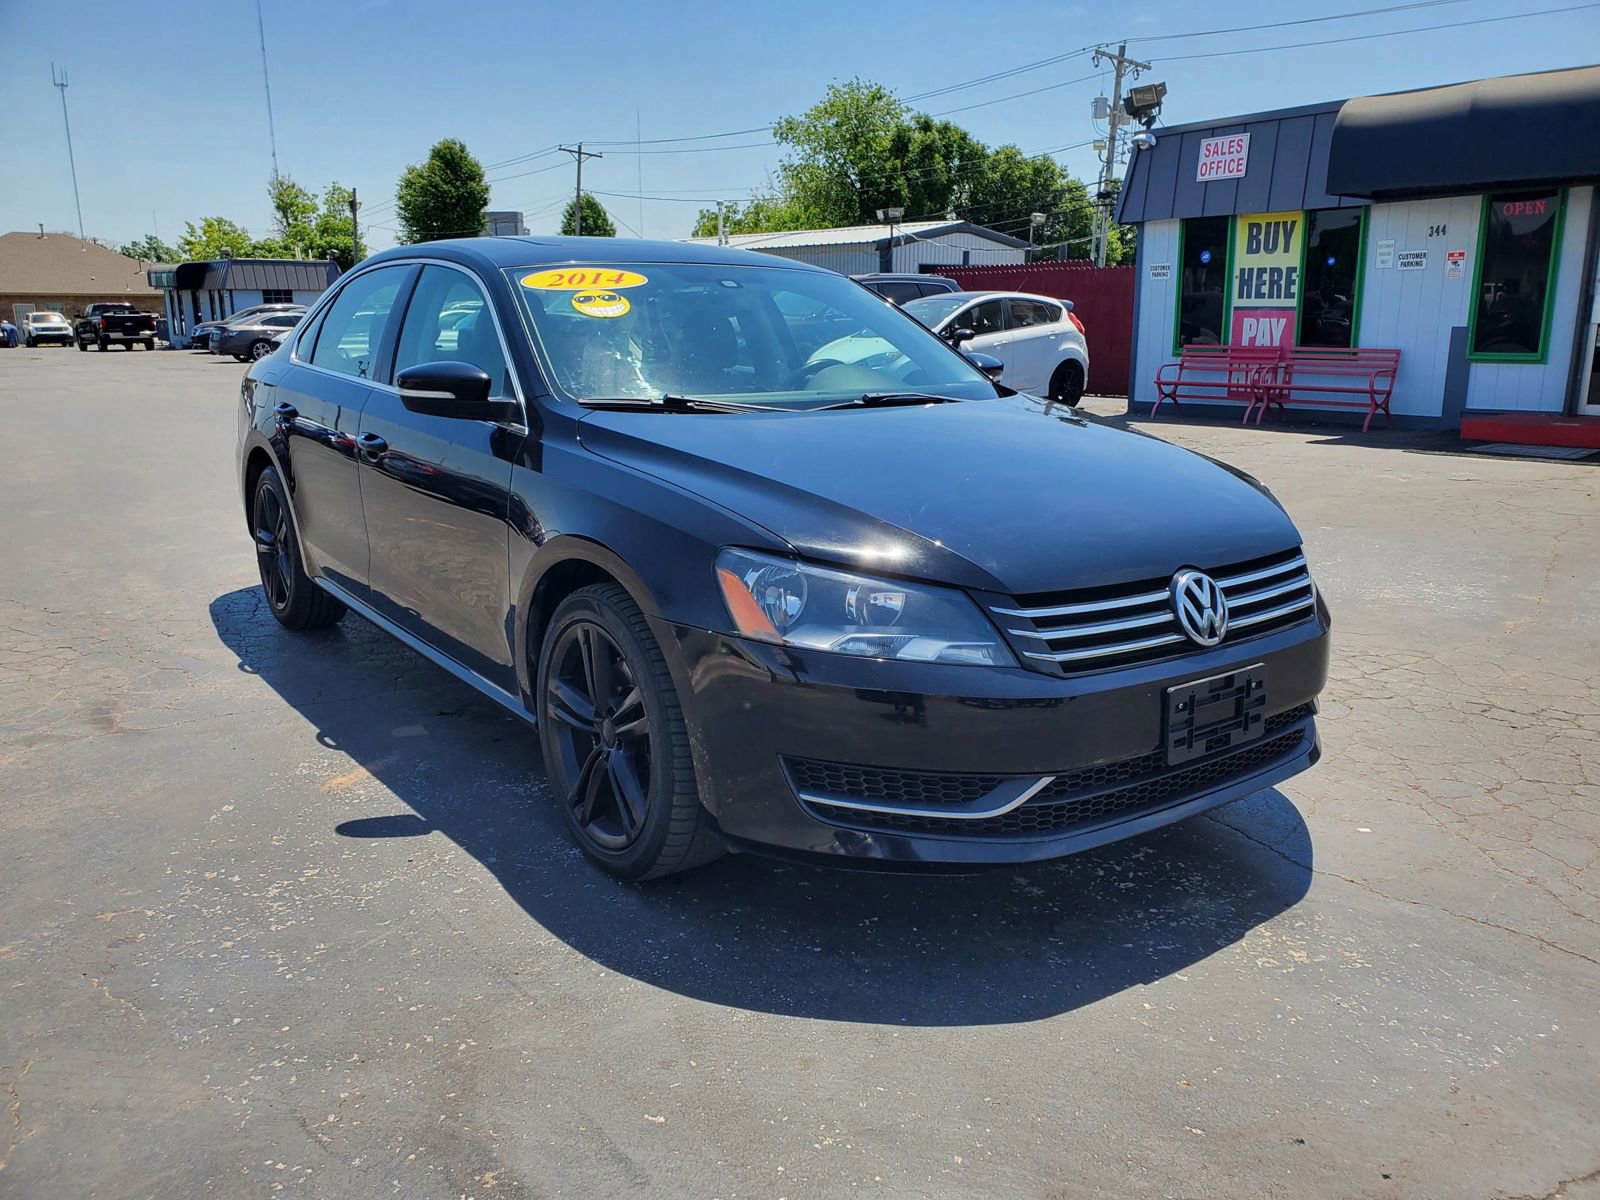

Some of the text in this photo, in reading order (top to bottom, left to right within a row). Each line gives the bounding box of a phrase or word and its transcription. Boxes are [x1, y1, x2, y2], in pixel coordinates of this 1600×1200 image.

[1204, 138, 1244, 158] SALES
[1200, 157, 1245, 177] OFFICE
[1503, 199, 1546, 216] OPEN
[1246, 220, 1297, 255] BUY
[1429, 224, 1447, 237] 344
[1398, 252, 1427, 260] CUSTOMER
[1400, 260, 1424, 268] PARKING
[547, 272, 625, 287] 2014
[1237, 266, 1298, 300] HERE
[1241, 317, 1287, 347] PAY
